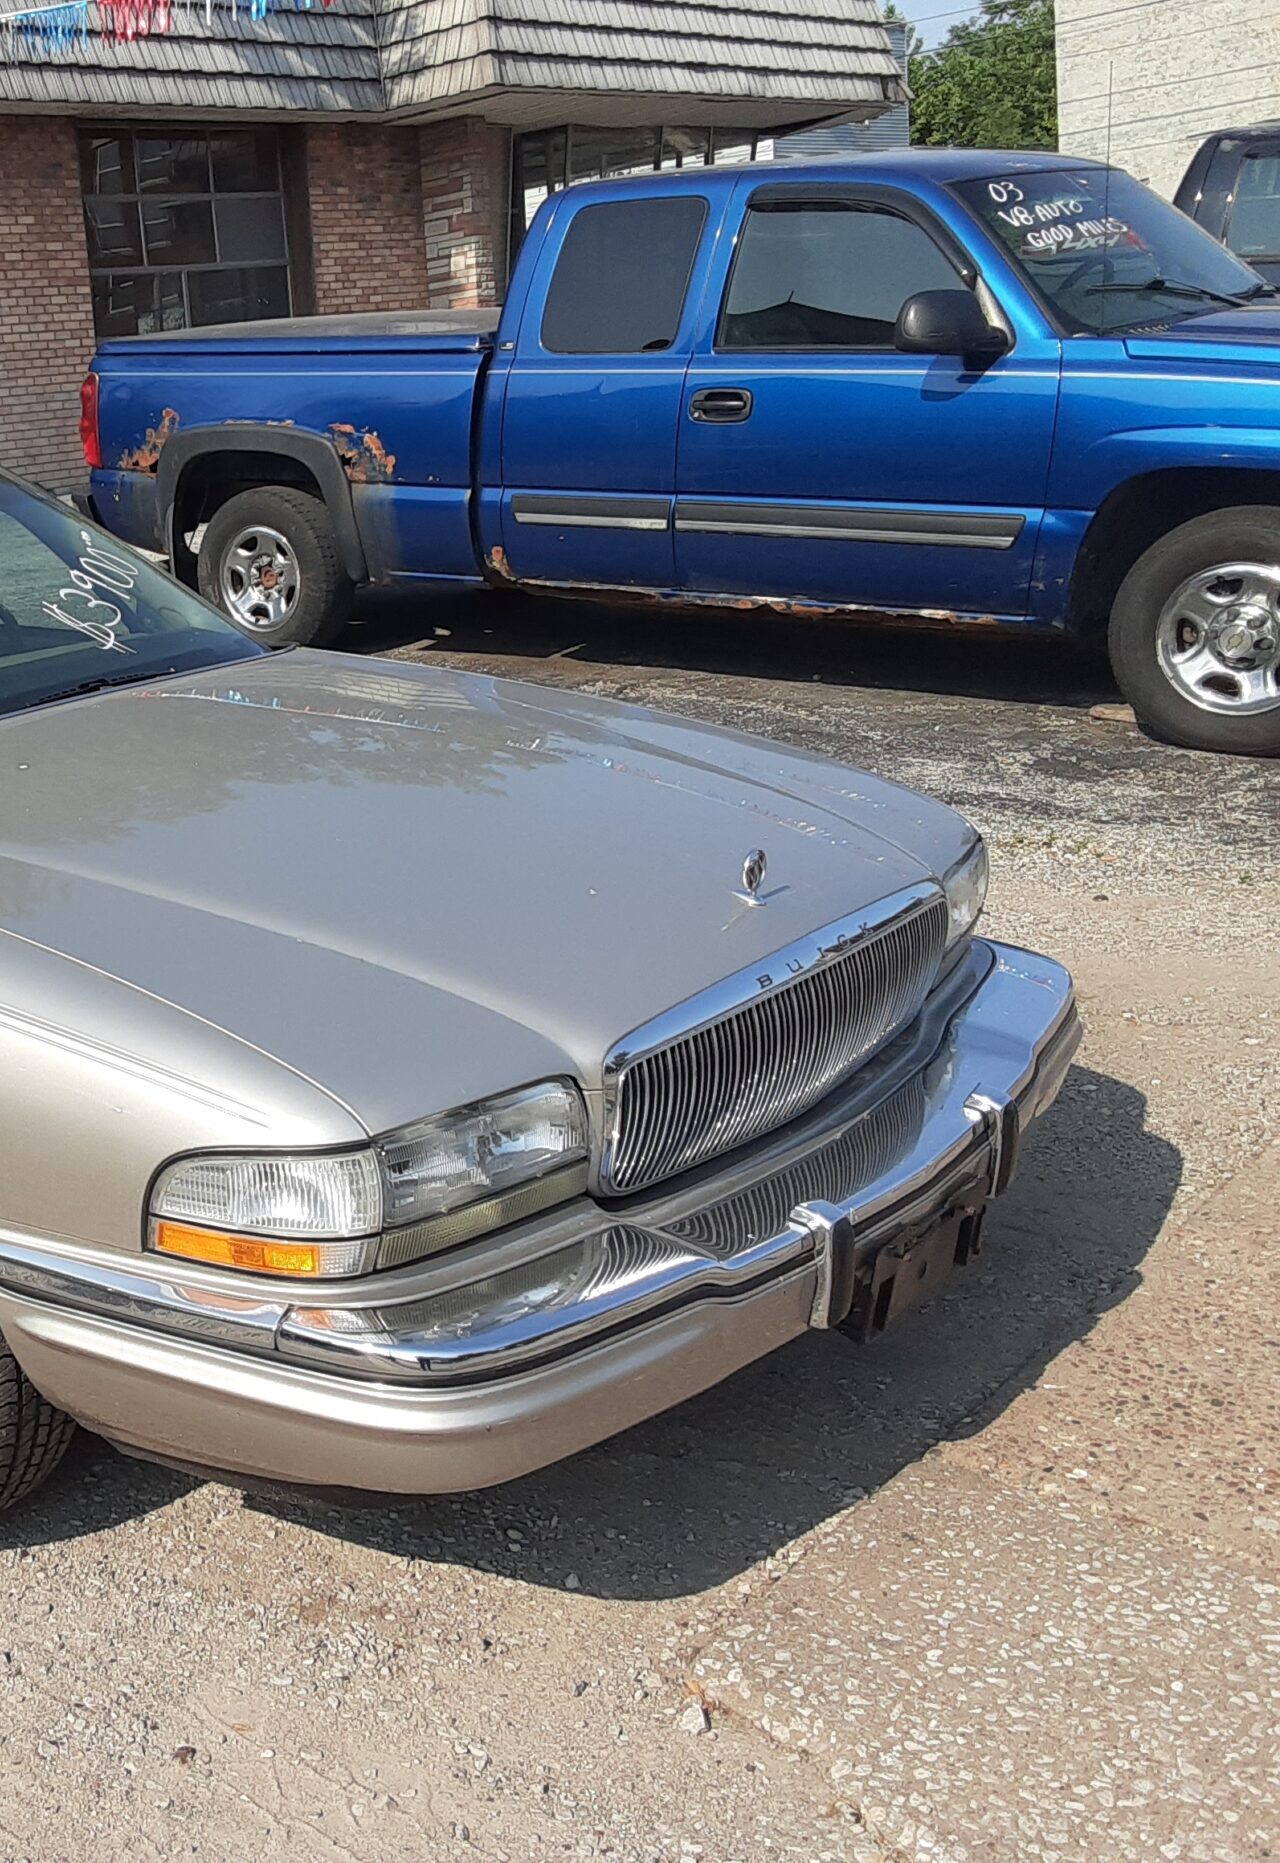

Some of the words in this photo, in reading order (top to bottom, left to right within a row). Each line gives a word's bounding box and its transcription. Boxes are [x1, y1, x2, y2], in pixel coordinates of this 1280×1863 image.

[988, 181, 1024, 202] 03
[1027, 224, 1073, 248] GOOD
[1076, 216, 1128, 237] MILES
[755, 922, 873, 989] BUICK
